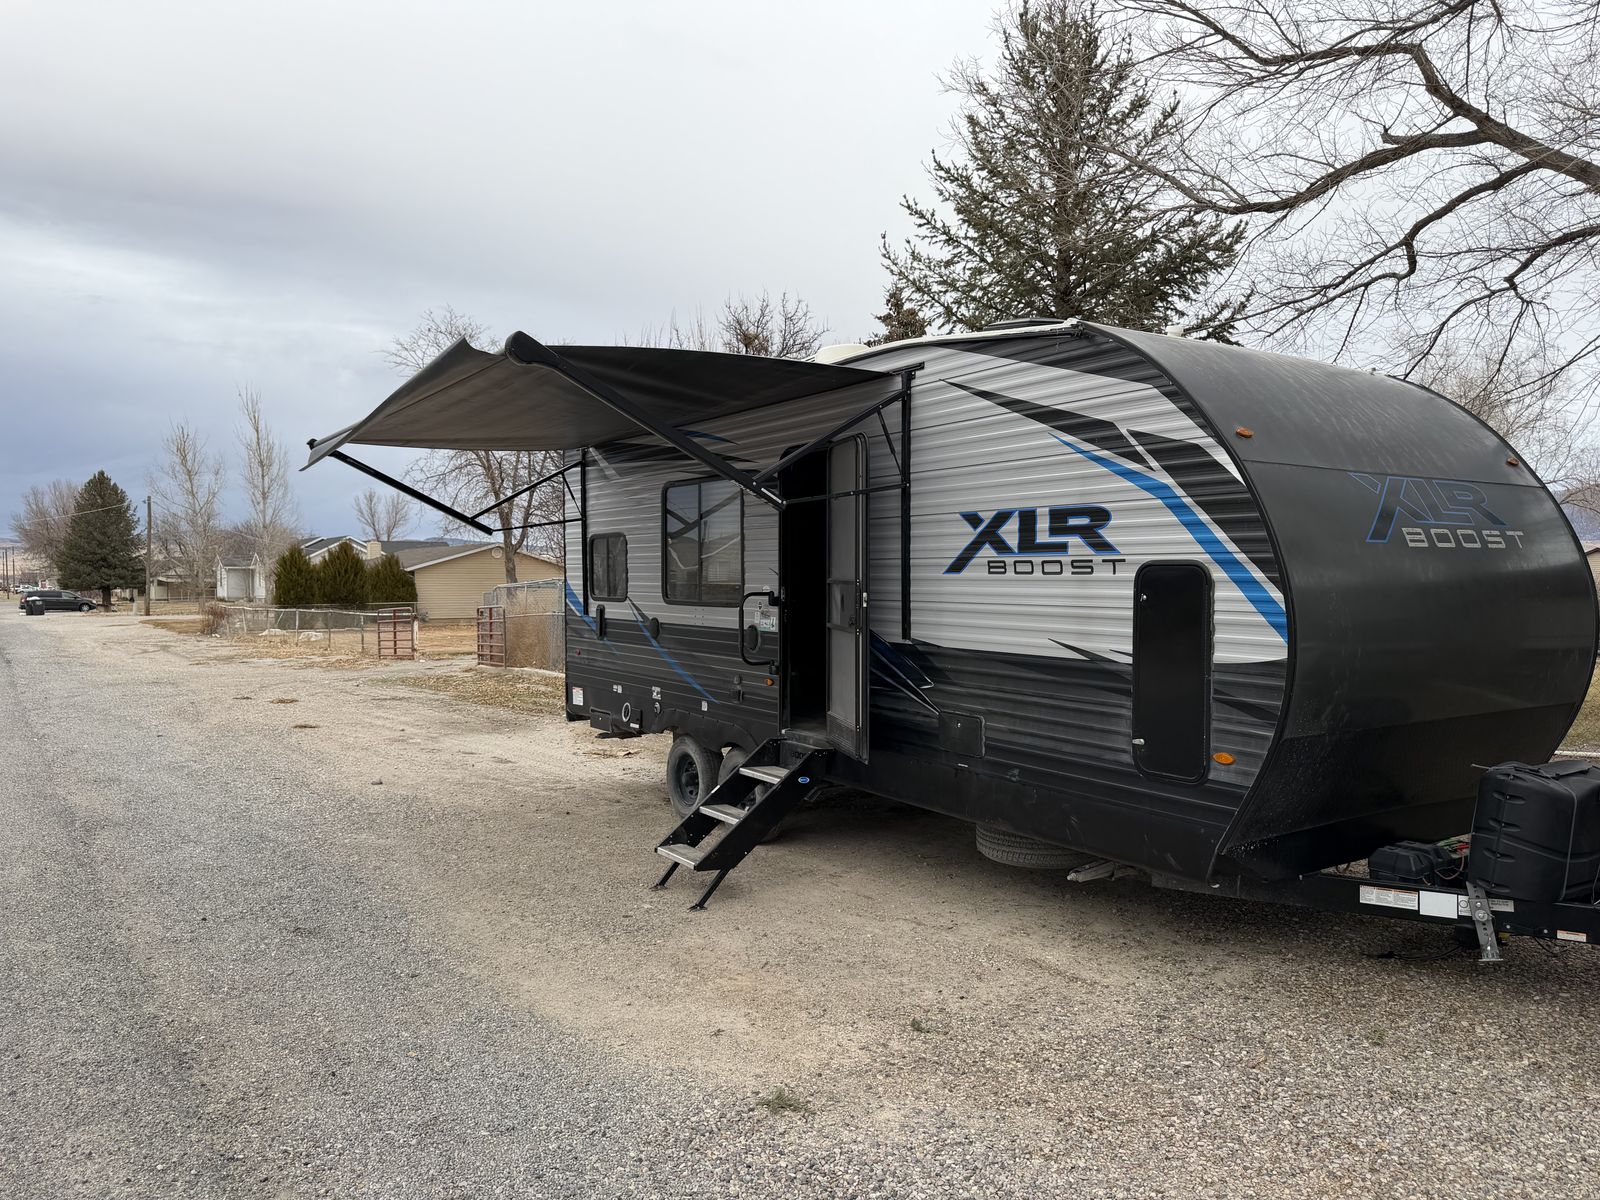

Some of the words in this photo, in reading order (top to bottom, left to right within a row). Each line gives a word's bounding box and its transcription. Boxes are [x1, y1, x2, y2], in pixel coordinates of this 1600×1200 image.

[1348, 472, 1508, 543] XLR
[943, 504, 1121, 574] XLR
[1402, 527, 1524, 549] BOOST
[987, 558, 1126, 575] BOOST
